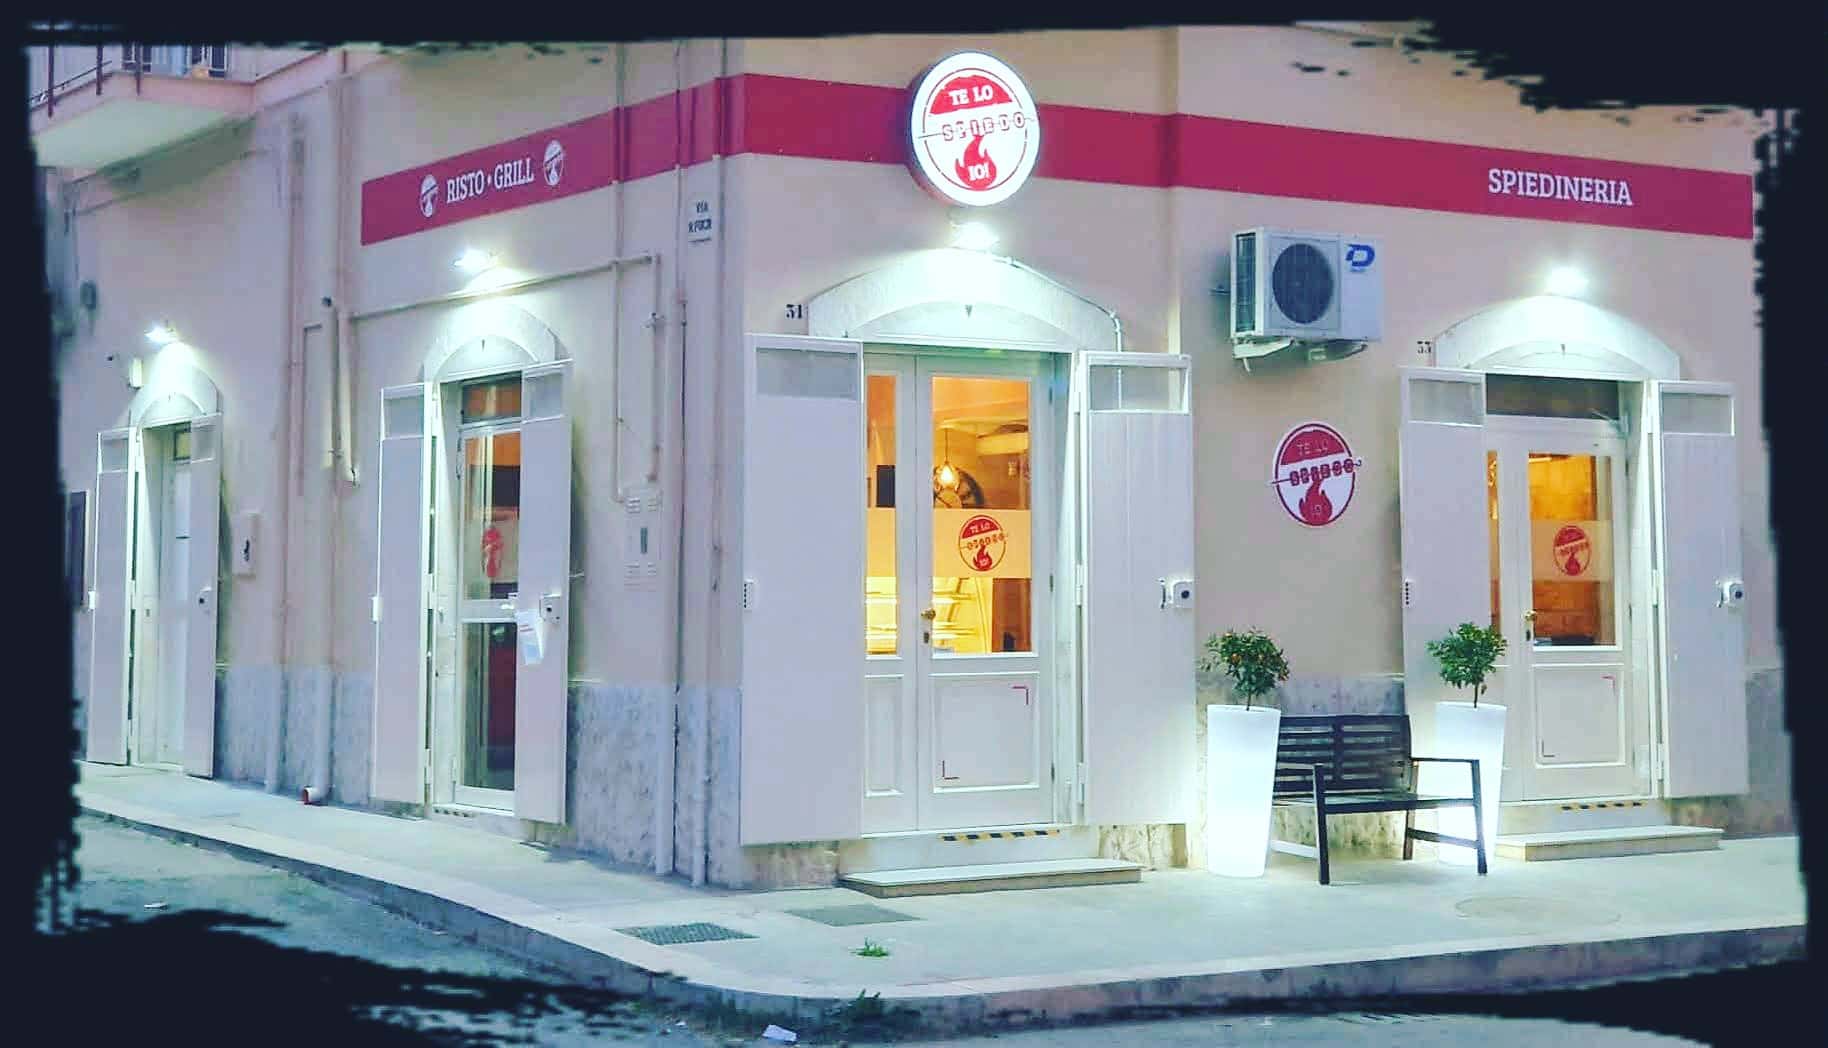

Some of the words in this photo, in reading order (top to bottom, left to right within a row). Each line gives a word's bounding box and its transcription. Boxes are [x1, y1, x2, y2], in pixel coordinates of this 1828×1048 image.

[948, 88, 970, 106] TE
[972, 85, 994, 103] LO
[942, 111, 1025, 142] SPIEDO
[446, 169, 485, 204] RISTO
[493, 157, 535, 189] GRILL
[1488, 168, 1633, 207] SPIEDINERIA
